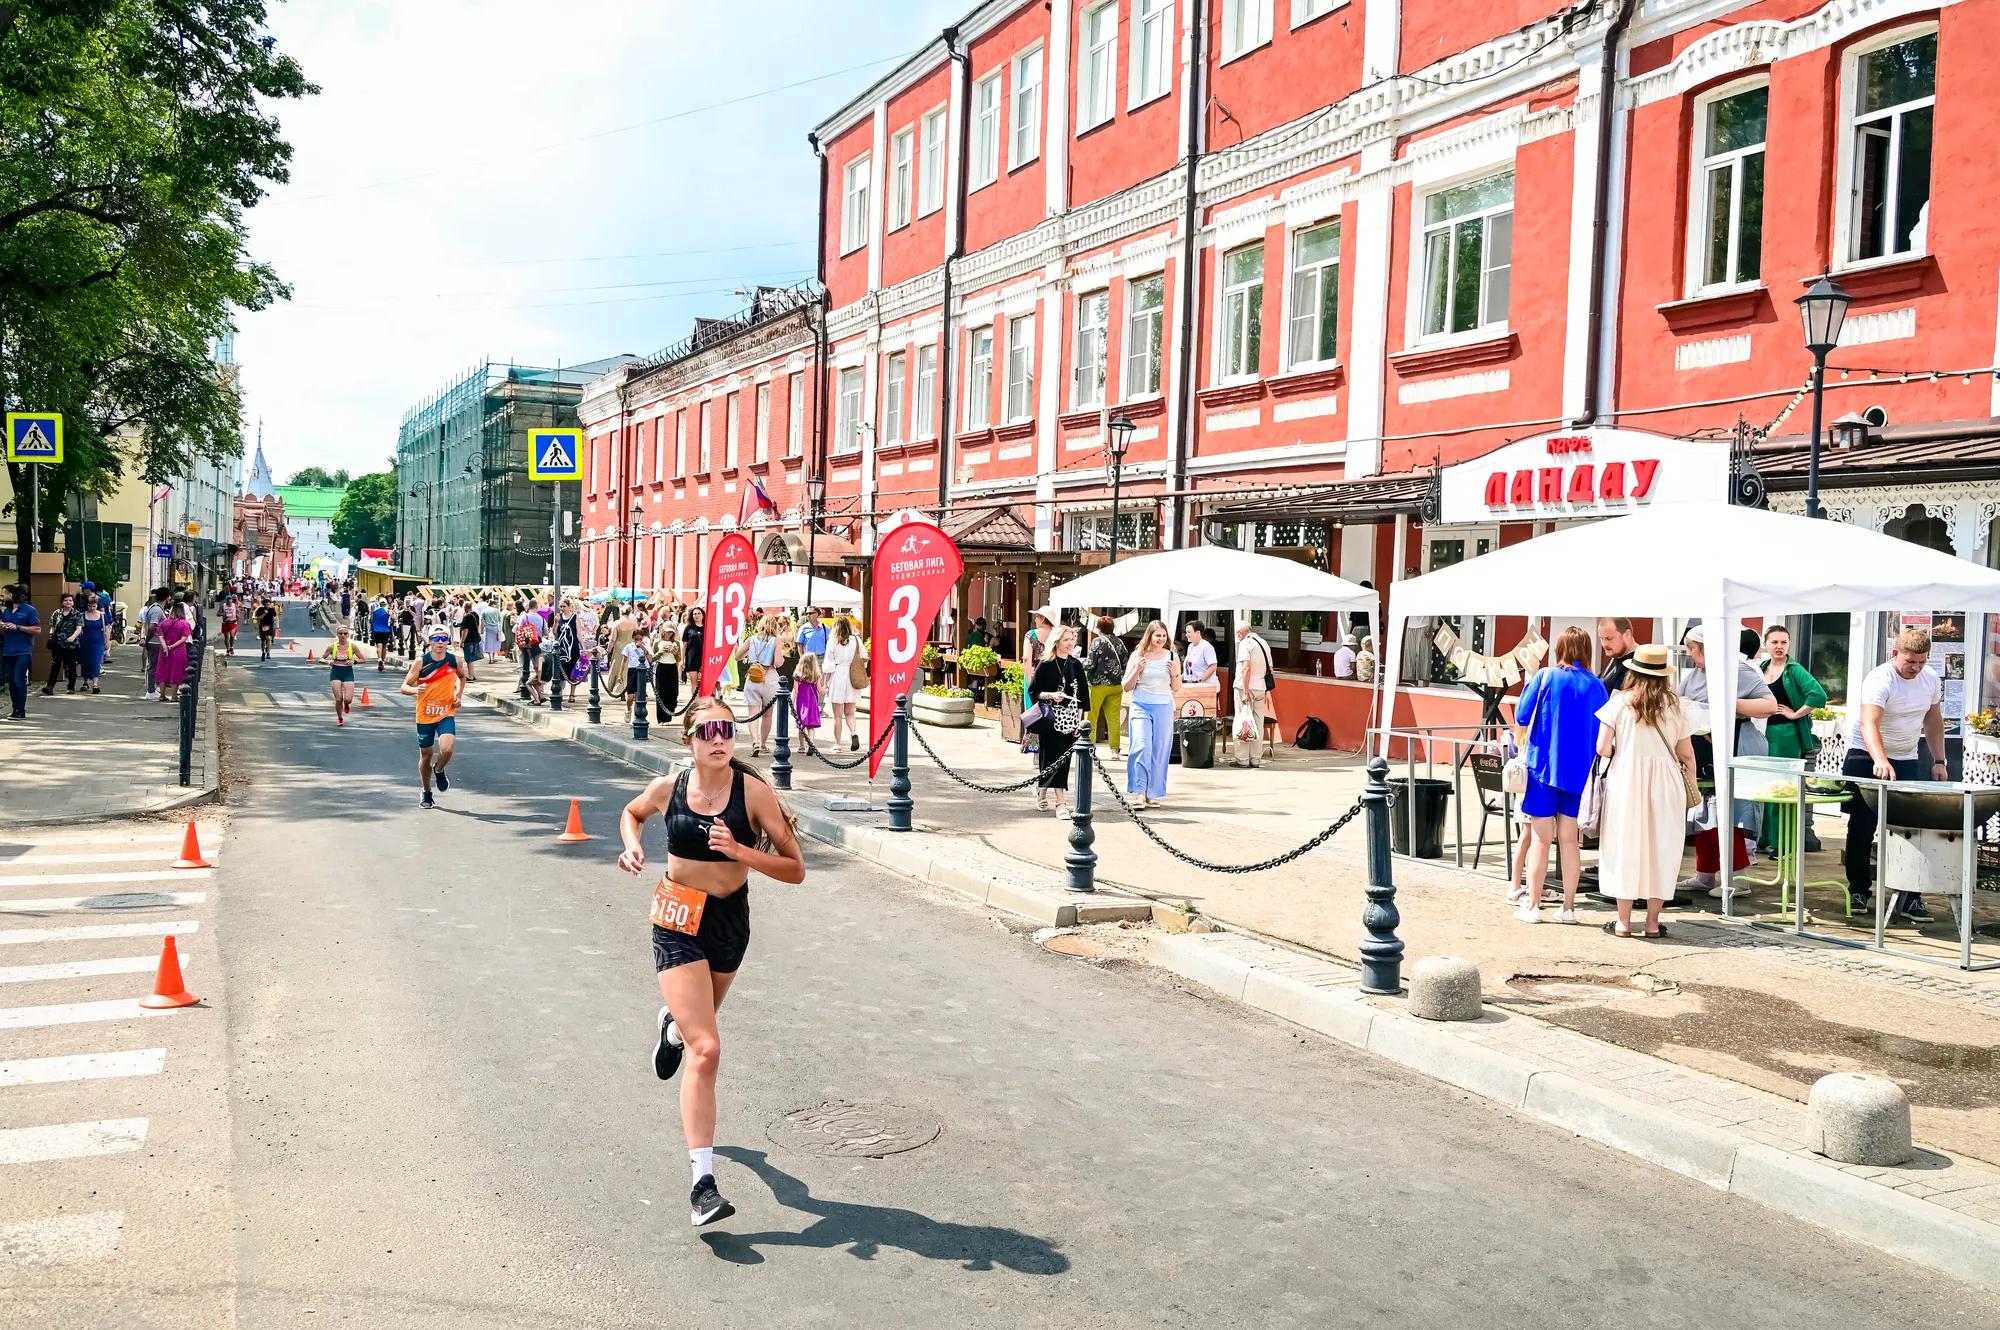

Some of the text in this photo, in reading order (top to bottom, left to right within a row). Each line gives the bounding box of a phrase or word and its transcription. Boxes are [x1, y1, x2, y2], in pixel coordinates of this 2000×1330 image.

[1484, 459, 1660, 505] ЛАНДАУ
[891, 557, 945, 574] БЕГОВАЯ ЛИГА
[711, 582, 746, 648] 13
[888, 585, 920, 663] 3
[426, 705, 444, 715] 5172
